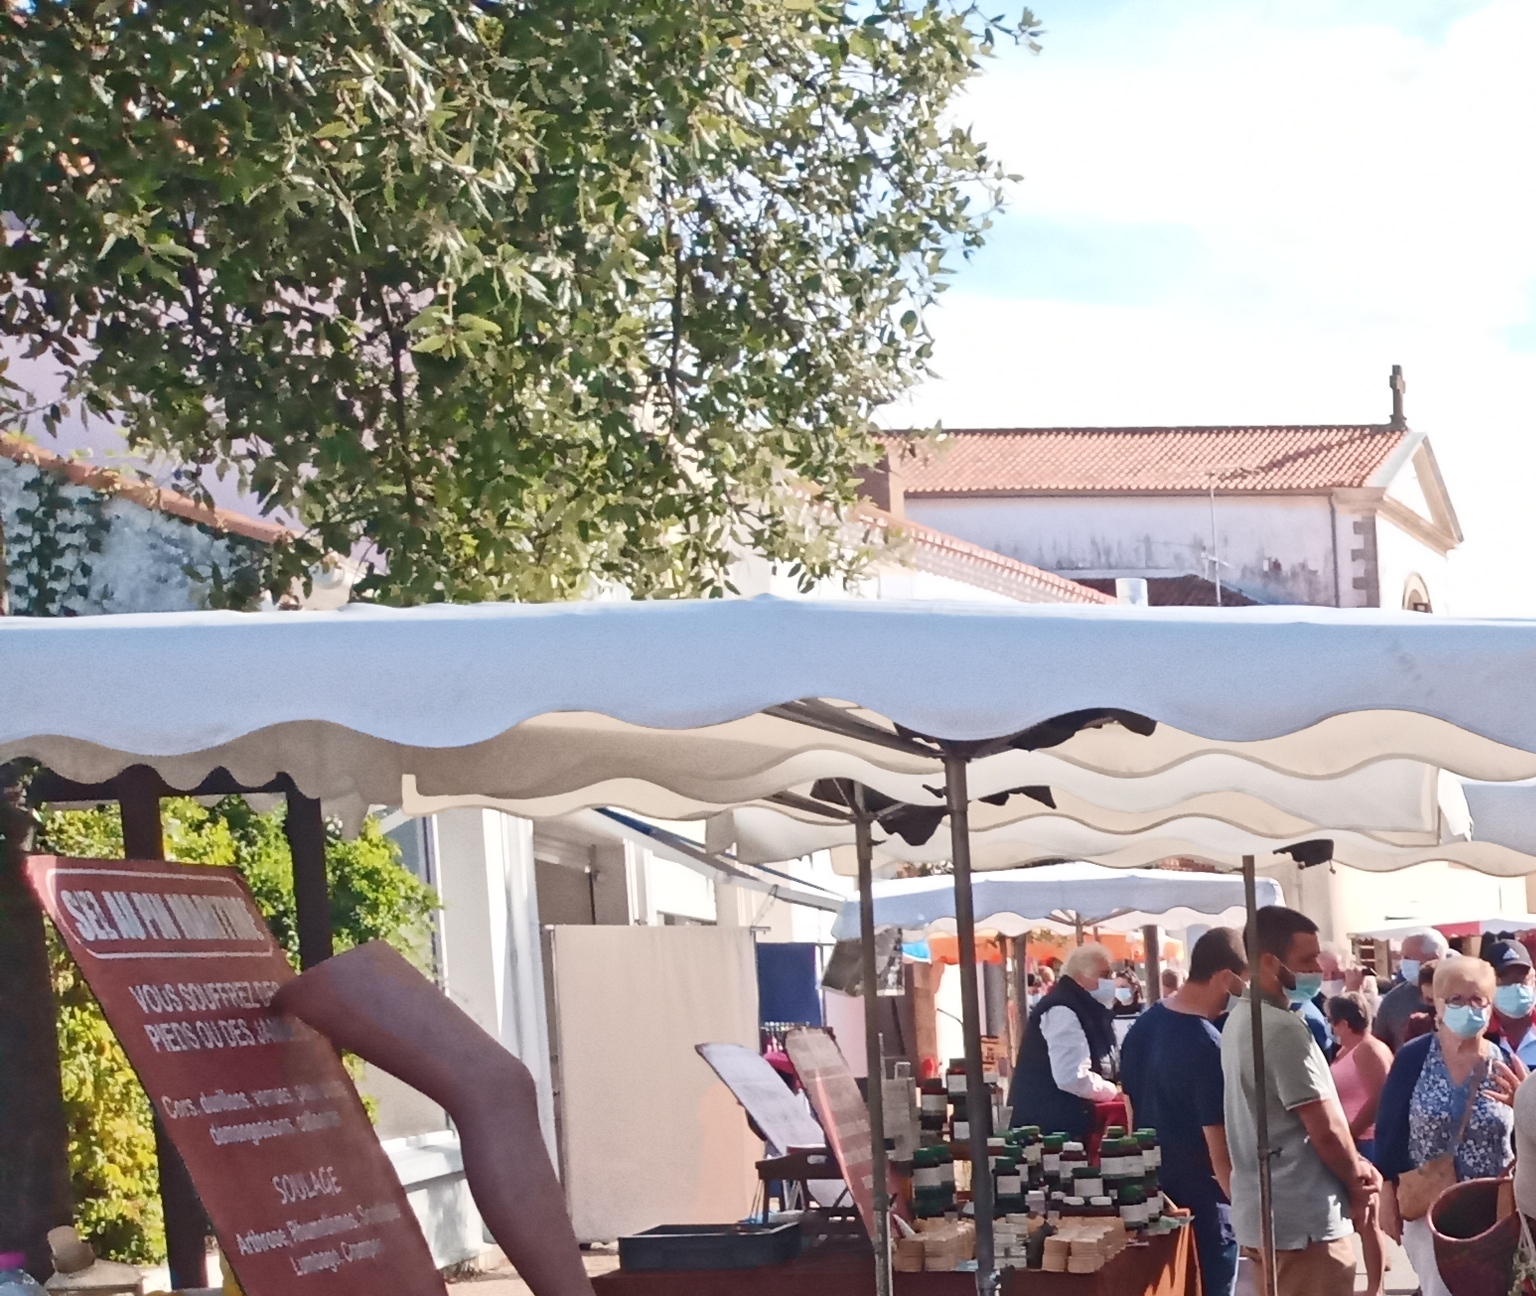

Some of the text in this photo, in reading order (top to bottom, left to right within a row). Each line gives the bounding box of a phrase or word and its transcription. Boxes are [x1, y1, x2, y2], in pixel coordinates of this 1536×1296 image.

[128, 983, 184, 1014] VOUS
[177, 981, 260, 1012] SOUFFREZ
[143, 1021, 201, 1052] PIEDS
[195, 1020, 224, 1049] OU
[218, 1018, 256, 1048] DES
[271, 1166, 342, 1204] SOULAGE
